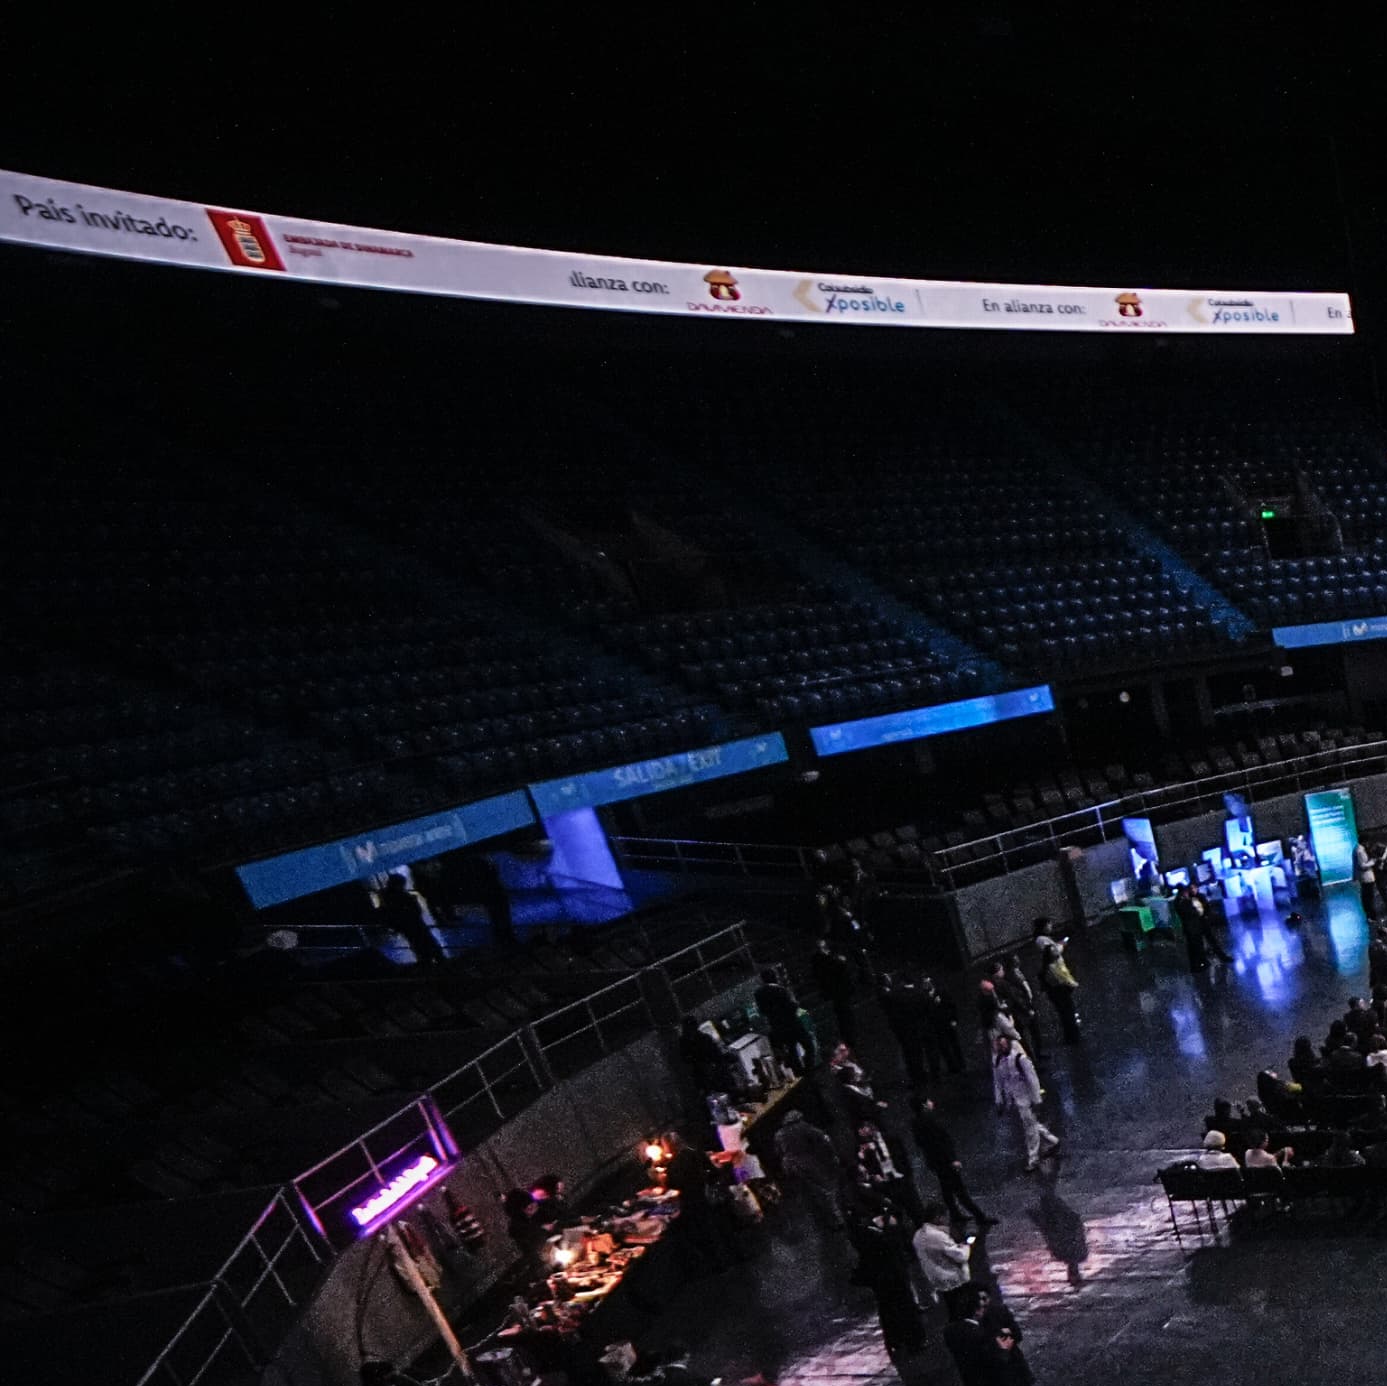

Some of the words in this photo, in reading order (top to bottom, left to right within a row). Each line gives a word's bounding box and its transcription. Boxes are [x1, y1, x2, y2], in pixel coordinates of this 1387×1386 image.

[76, 203, 198, 242] invitado:
[632, 279, 670, 295] con:
[982, 298, 1000, 312] En
[1003, 299, 1054, 315] alianza
[1057, 301, 1087, 315] con:
[1327, 306, 1343, 320] En
